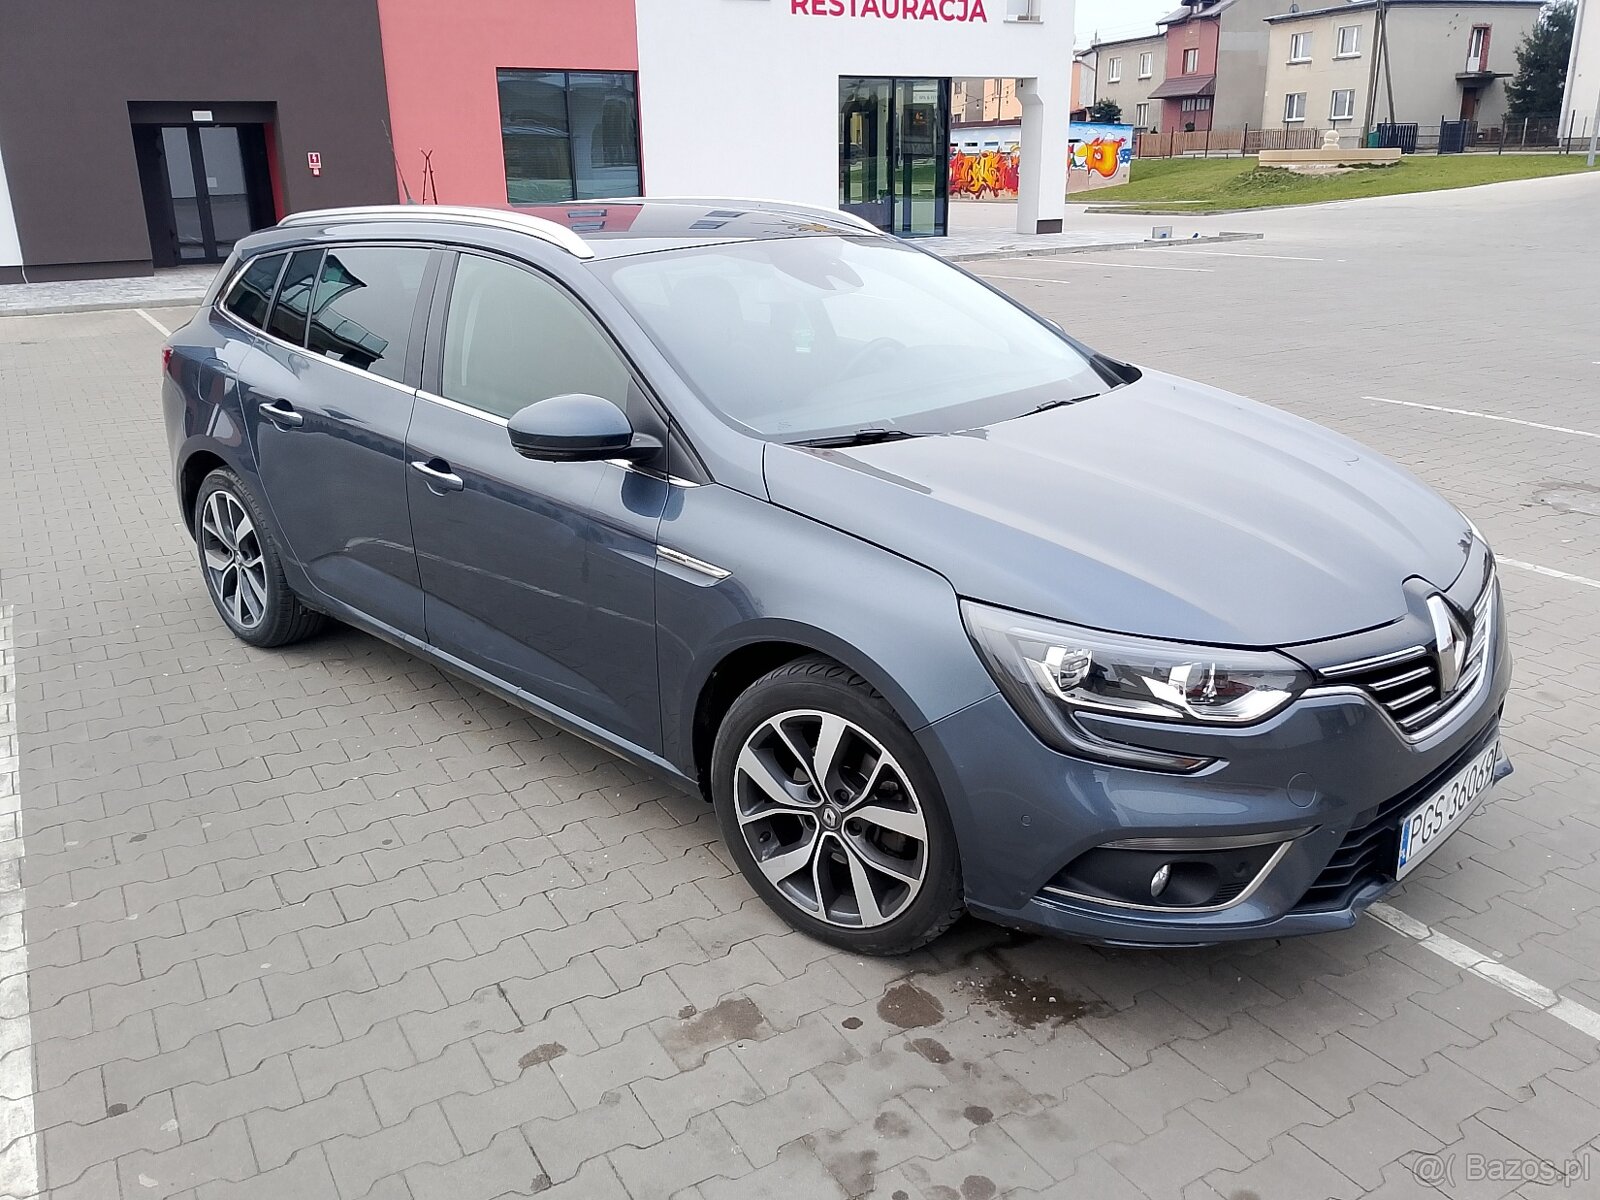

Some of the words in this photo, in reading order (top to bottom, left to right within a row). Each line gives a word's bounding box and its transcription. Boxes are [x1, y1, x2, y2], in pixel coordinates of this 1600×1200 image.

[791, 0, 988, 23] RESTAURACJA
[1408, 795, 1446, 857] PGS
[1448, 748, 1495, 820] 36069
